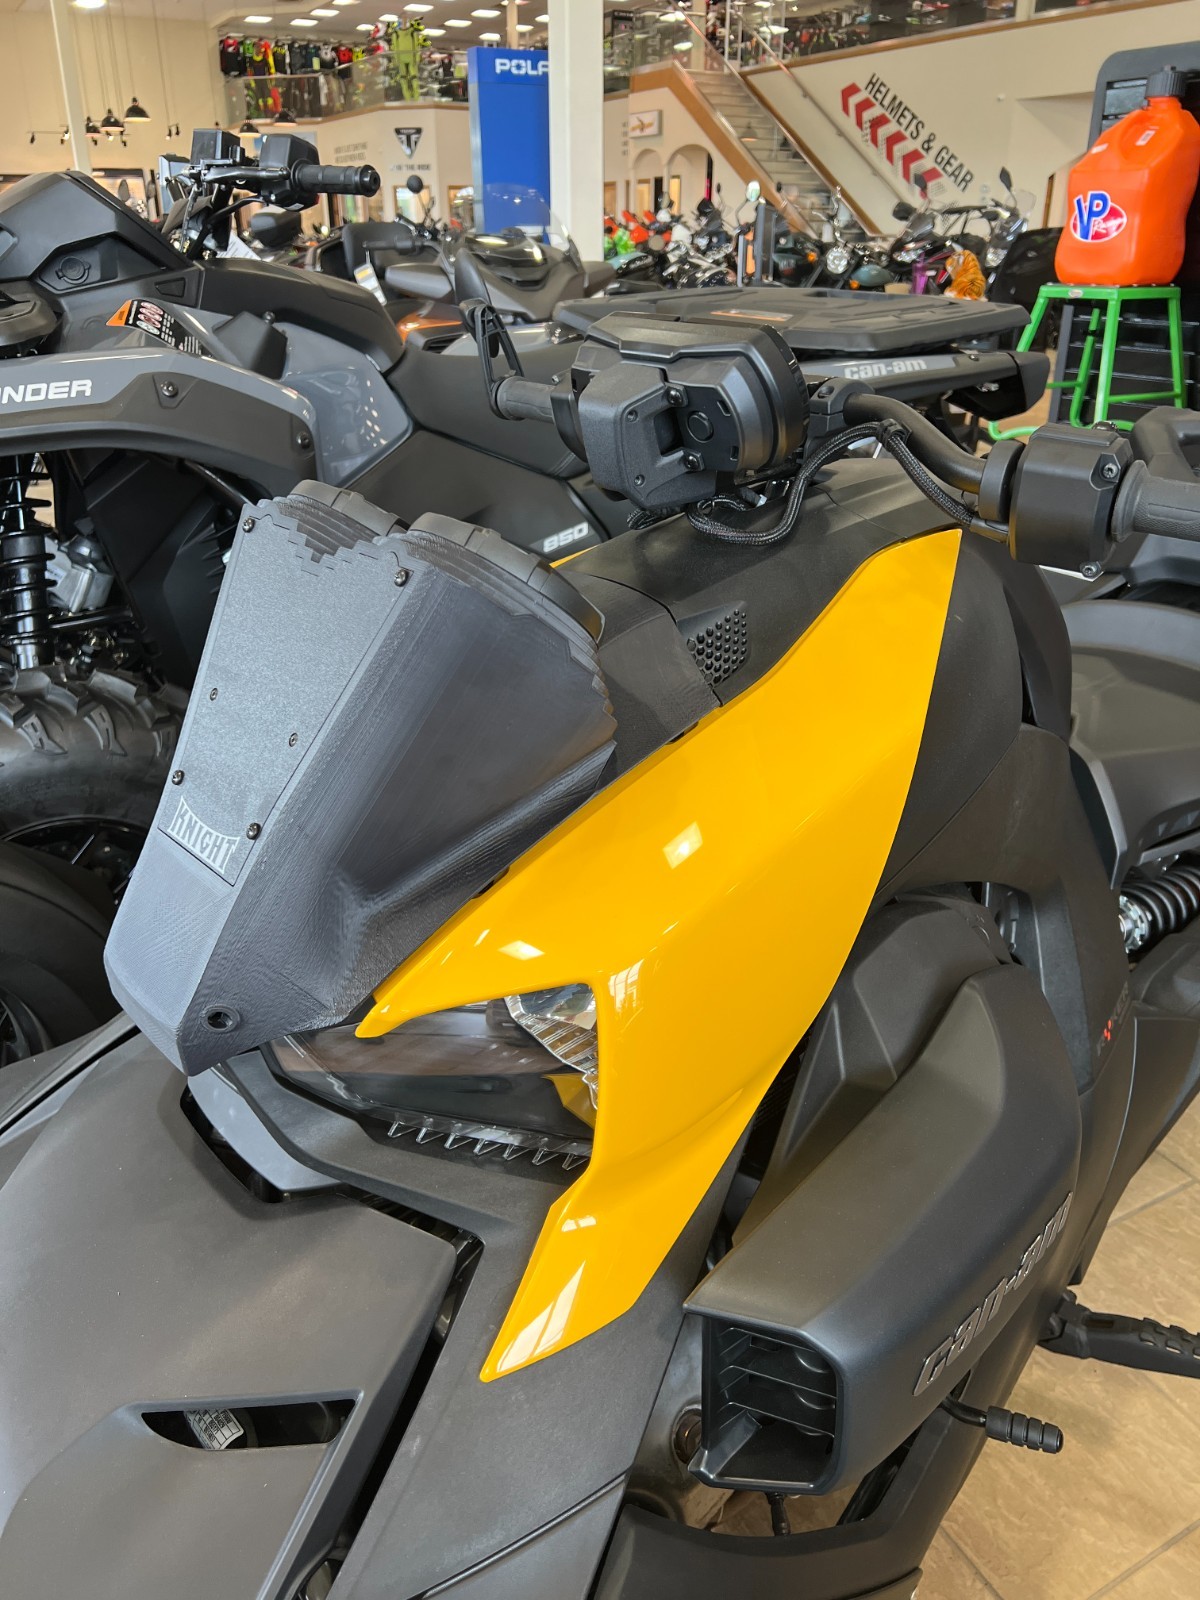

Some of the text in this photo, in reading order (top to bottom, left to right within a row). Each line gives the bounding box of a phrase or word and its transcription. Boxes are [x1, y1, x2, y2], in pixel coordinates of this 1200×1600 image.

[864, 72, 974, 193] HELMETS & GEAR
[1073, 190, 1111, 241] VP
[0, 379, 93, 405] NDER
[844, 359, 927, 380] can-am
[543, 521, 588, 553] 850
[167, 798, 239, 874] KNIGHT
[913, 1192, 1073, 1396] can-am
